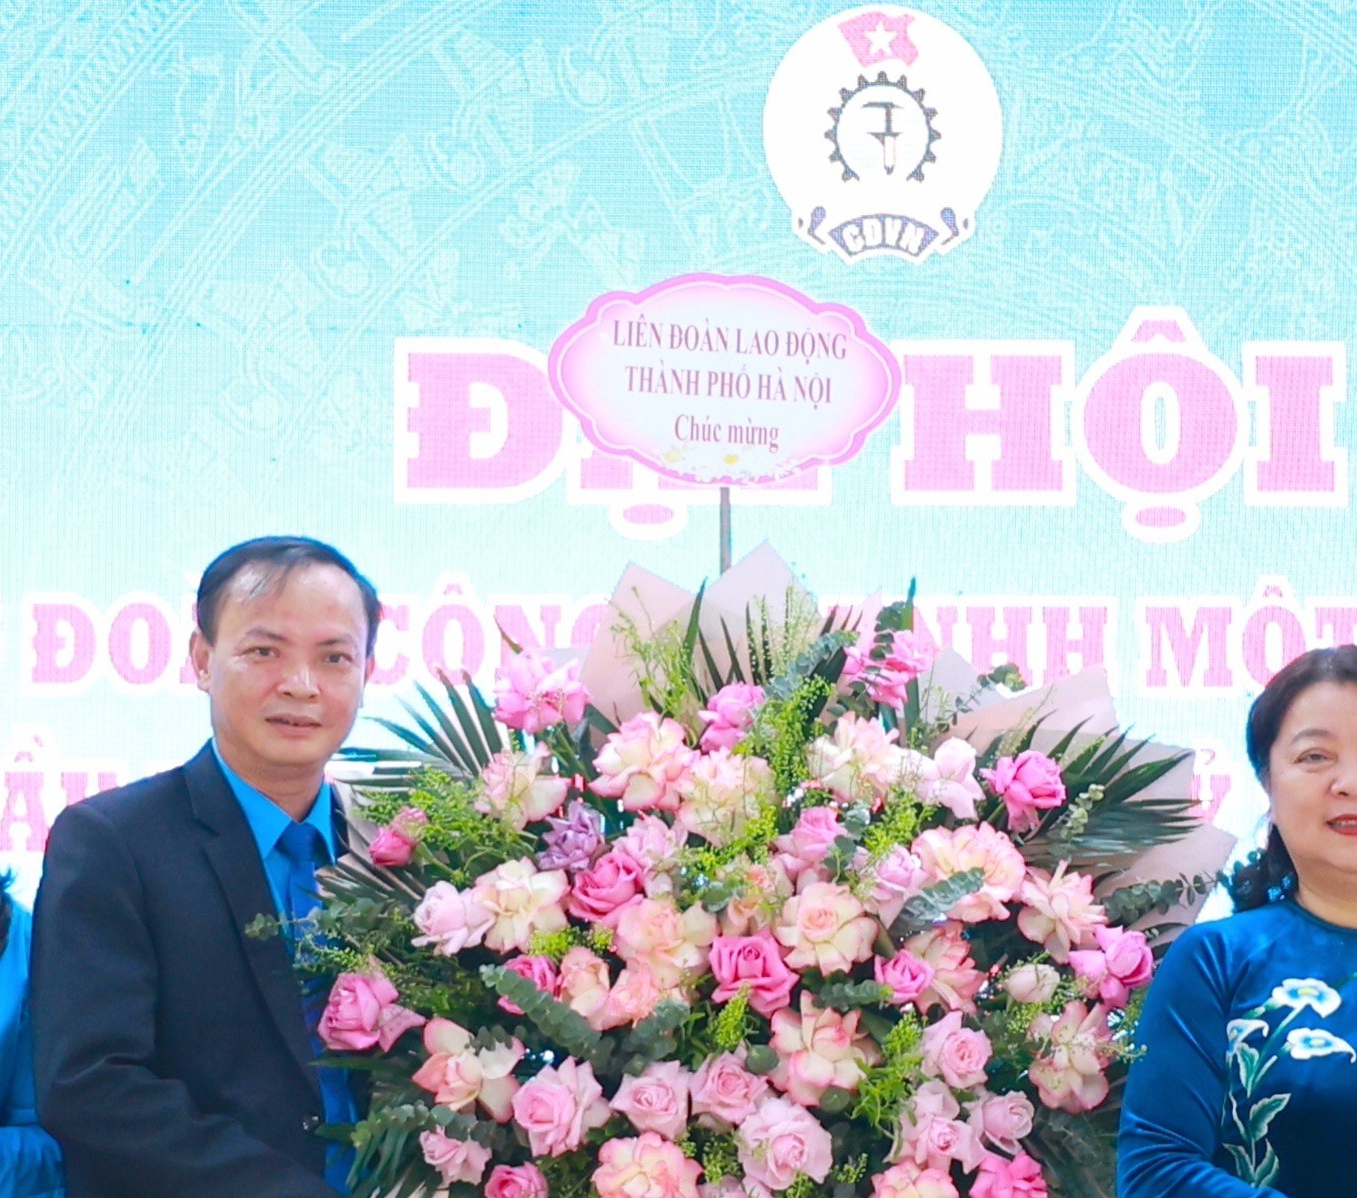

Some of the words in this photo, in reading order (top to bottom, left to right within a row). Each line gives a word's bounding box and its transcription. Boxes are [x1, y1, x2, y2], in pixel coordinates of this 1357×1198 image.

[612, 313, 664, 350] LIÊN
[668, 318, 730, 353] ĐOÀN
[735, 327, 780, 356] LAO
[785, 327, 848, 365] ĐỘNG
[625, 358, 701, 397] THÀNH
[706, 364, 752, 400] PHỐ
[756, 366, 788, 402] HÀ
[793, 372, 833, 410] NỘI
[674, 413, 722, 443] Chúc
[727, 417, 781, 454] mừng
[902, 318, 1337, 530] HỘI
[30, 601, 200, 685] ĐO
